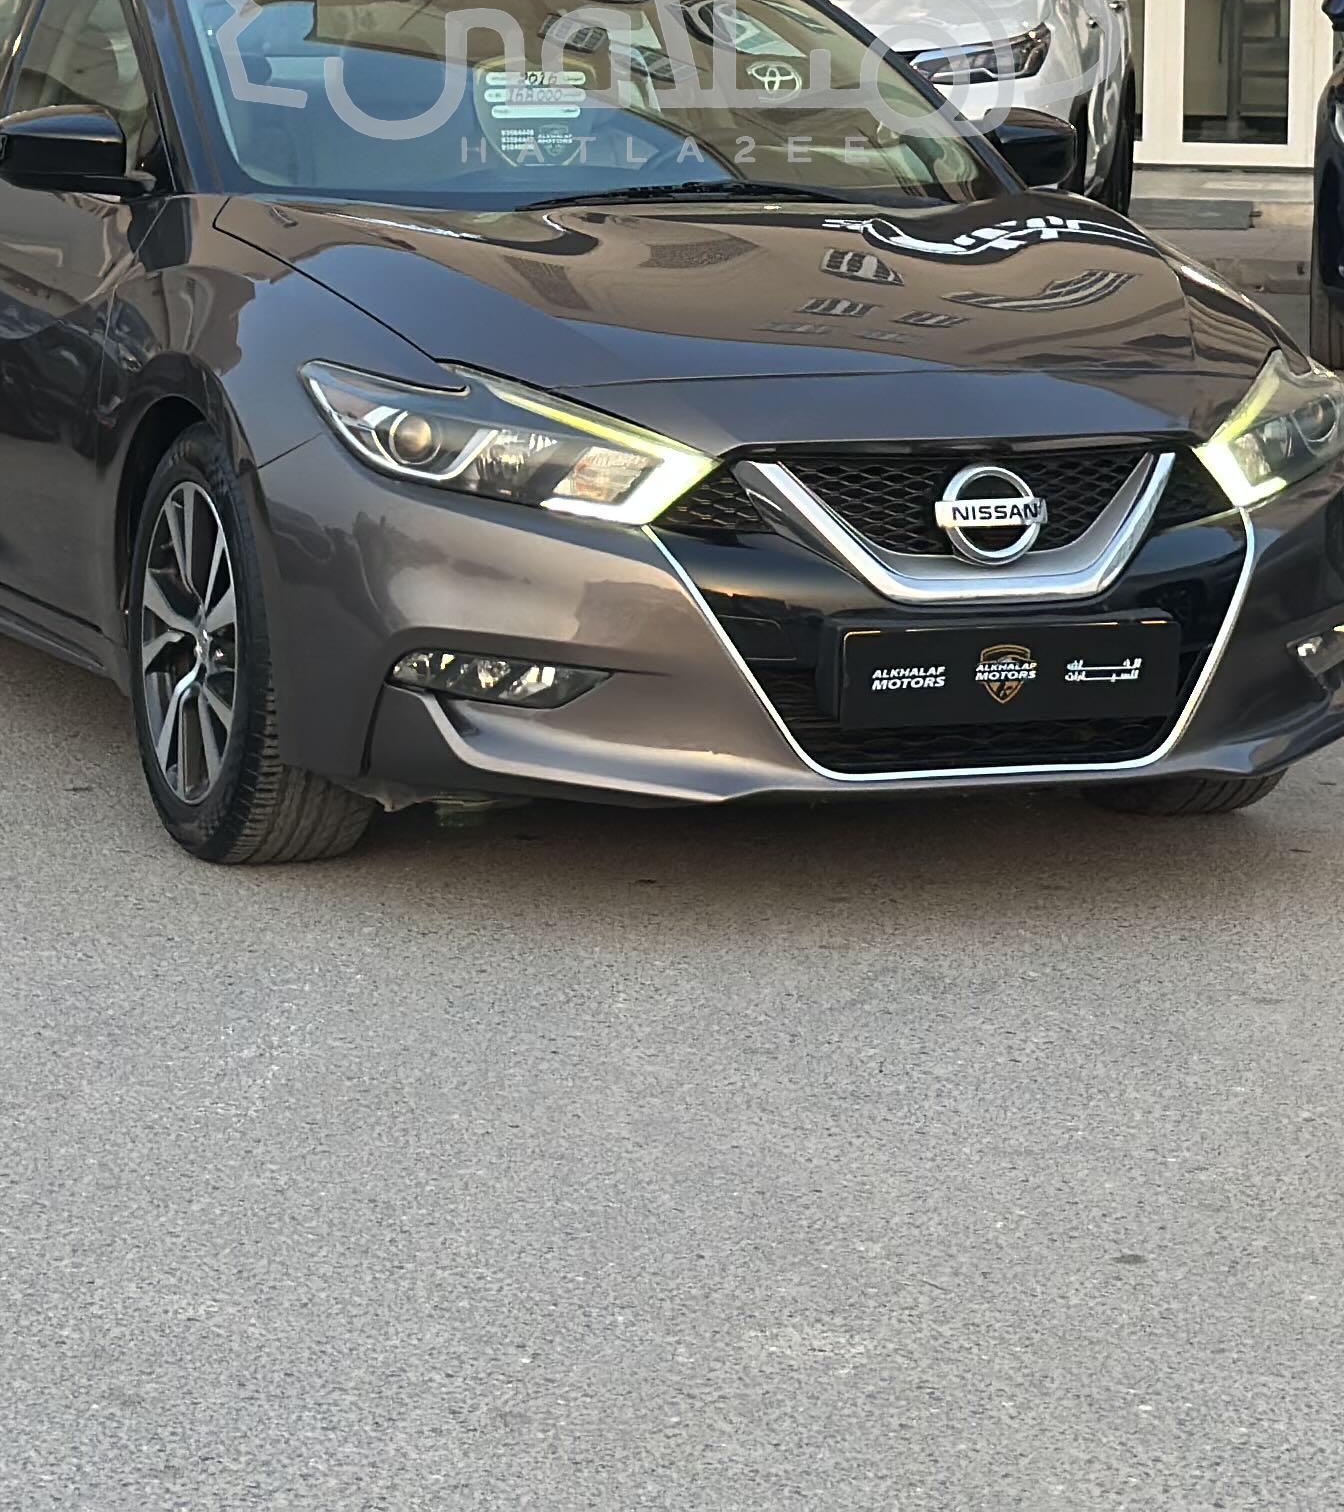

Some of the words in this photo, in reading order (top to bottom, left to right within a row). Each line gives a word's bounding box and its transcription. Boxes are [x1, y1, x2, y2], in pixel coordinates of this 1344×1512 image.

[951, 503, 1040, 521] NISSAN
[872, 666, 946, 680] ALKHALAF
[975, 662, 1038, 672] ALKHALAF
[974, 670, 1037, 681] MOTORS
[871, 676, 946, 691] MOTORS
